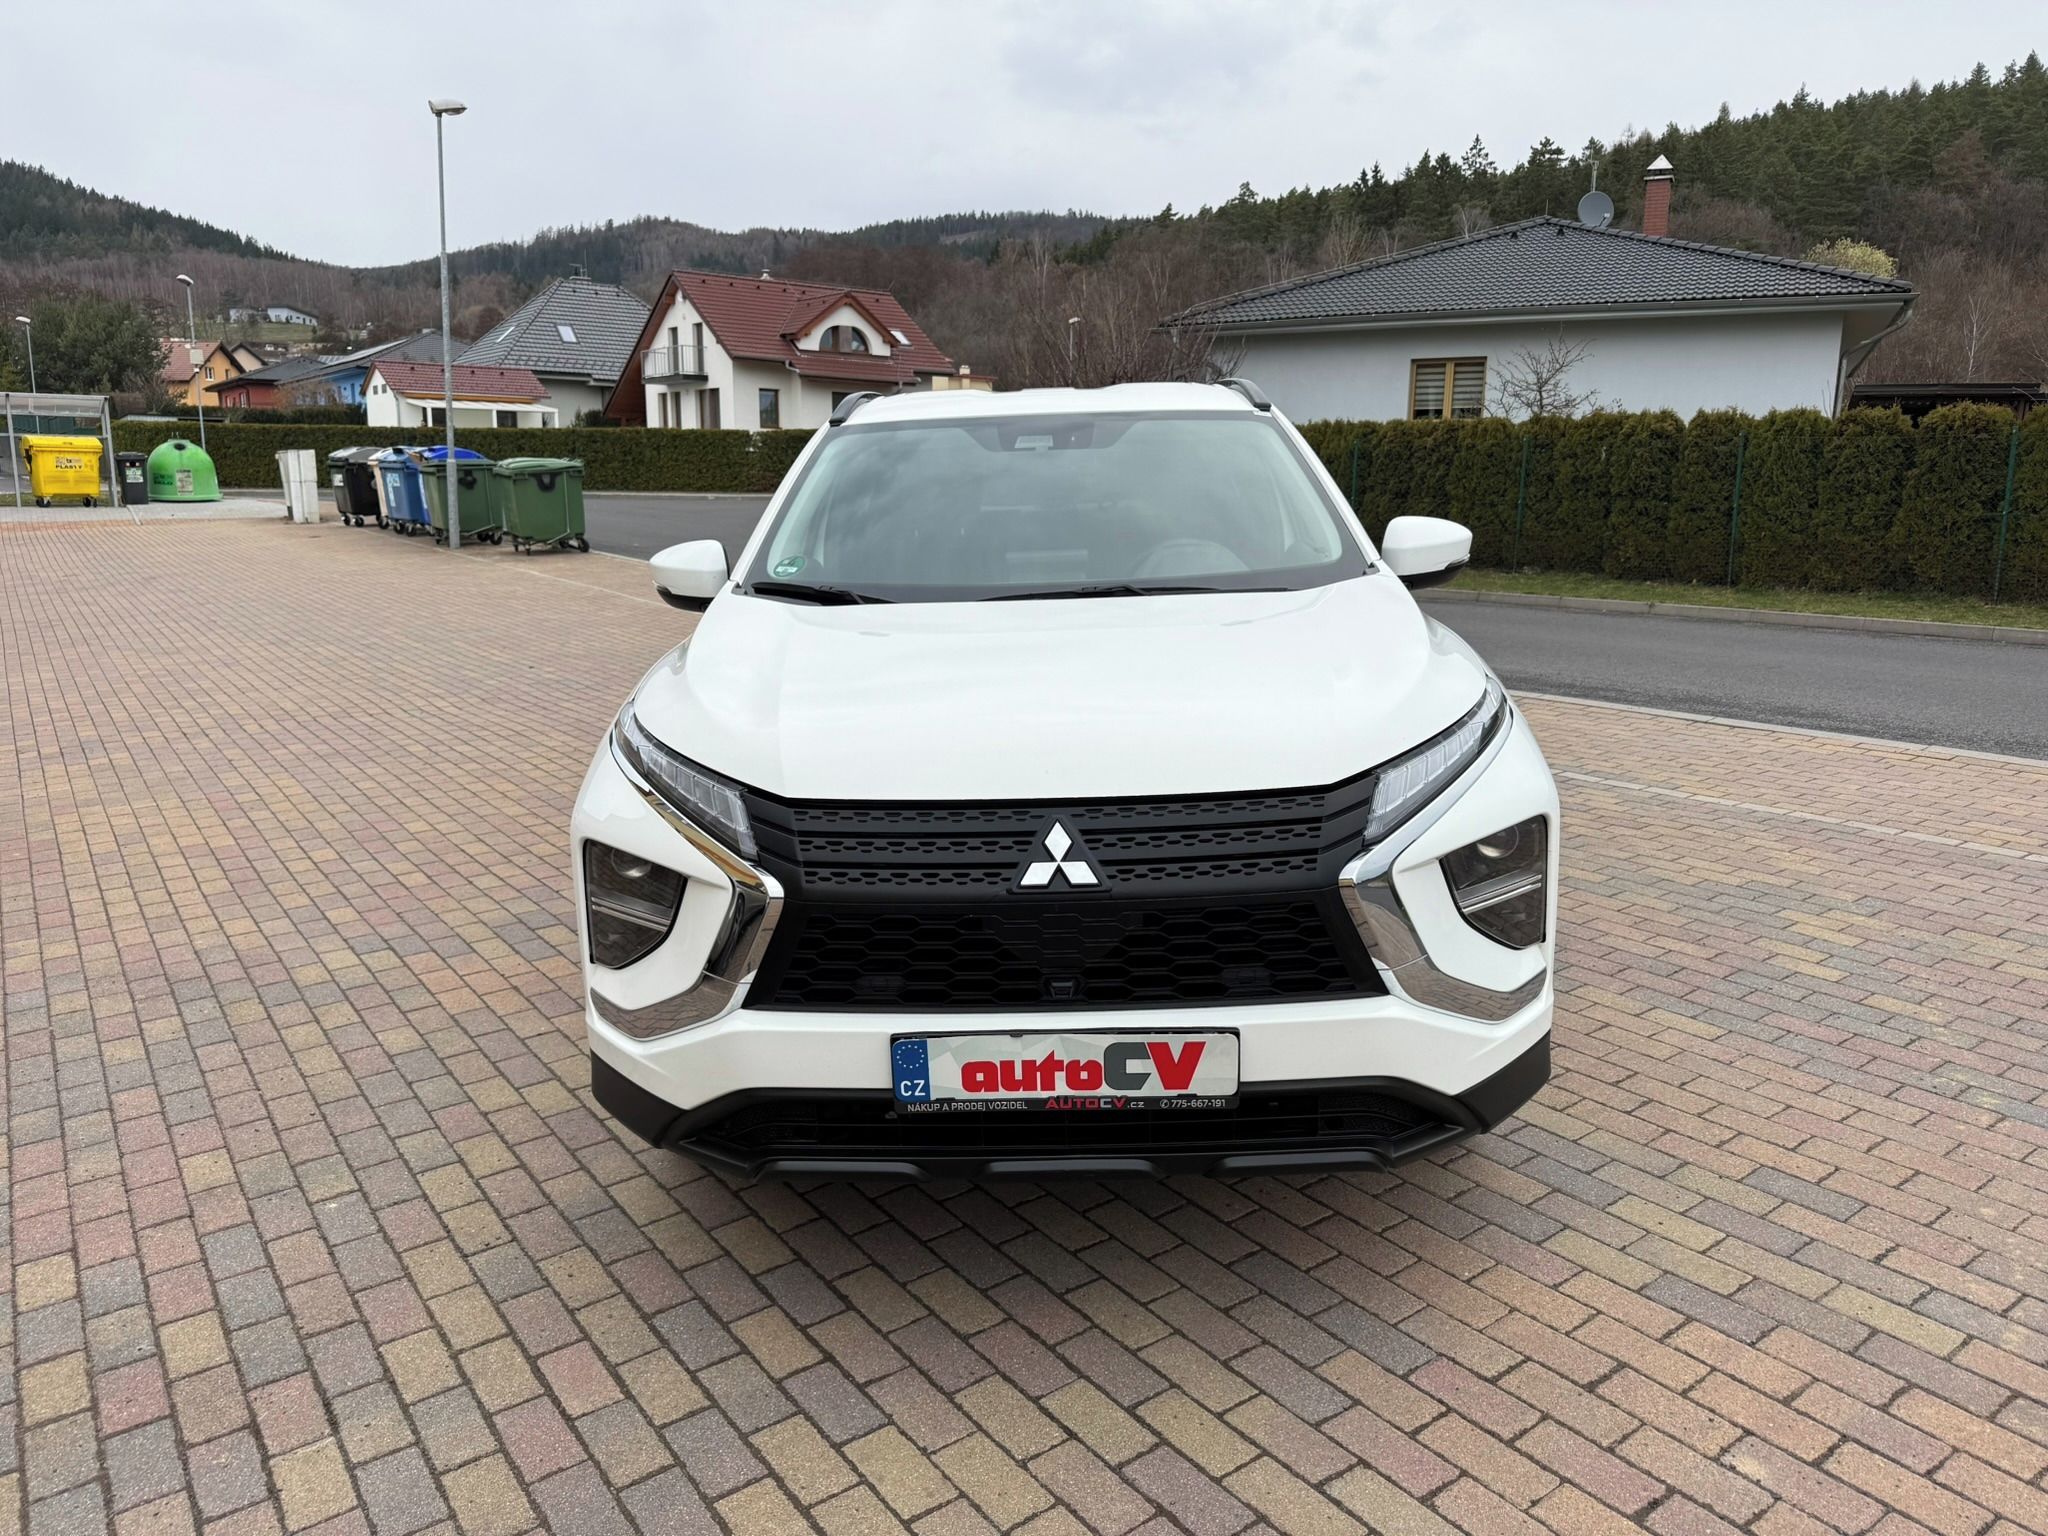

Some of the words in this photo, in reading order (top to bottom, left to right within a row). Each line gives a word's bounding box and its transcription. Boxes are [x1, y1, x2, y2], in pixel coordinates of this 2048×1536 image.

[900, 1079, 926, 1097] CZ
[907, 1102, 941, 1112] NÁKUP
[942, 1103, 950, 1111] A
[951, 1102, 986, 1111] PRODEJ
[988, 1101, 1028, 1110] VOZIDEL
[1171, 1098, 1226, 1108] 775-667-191
